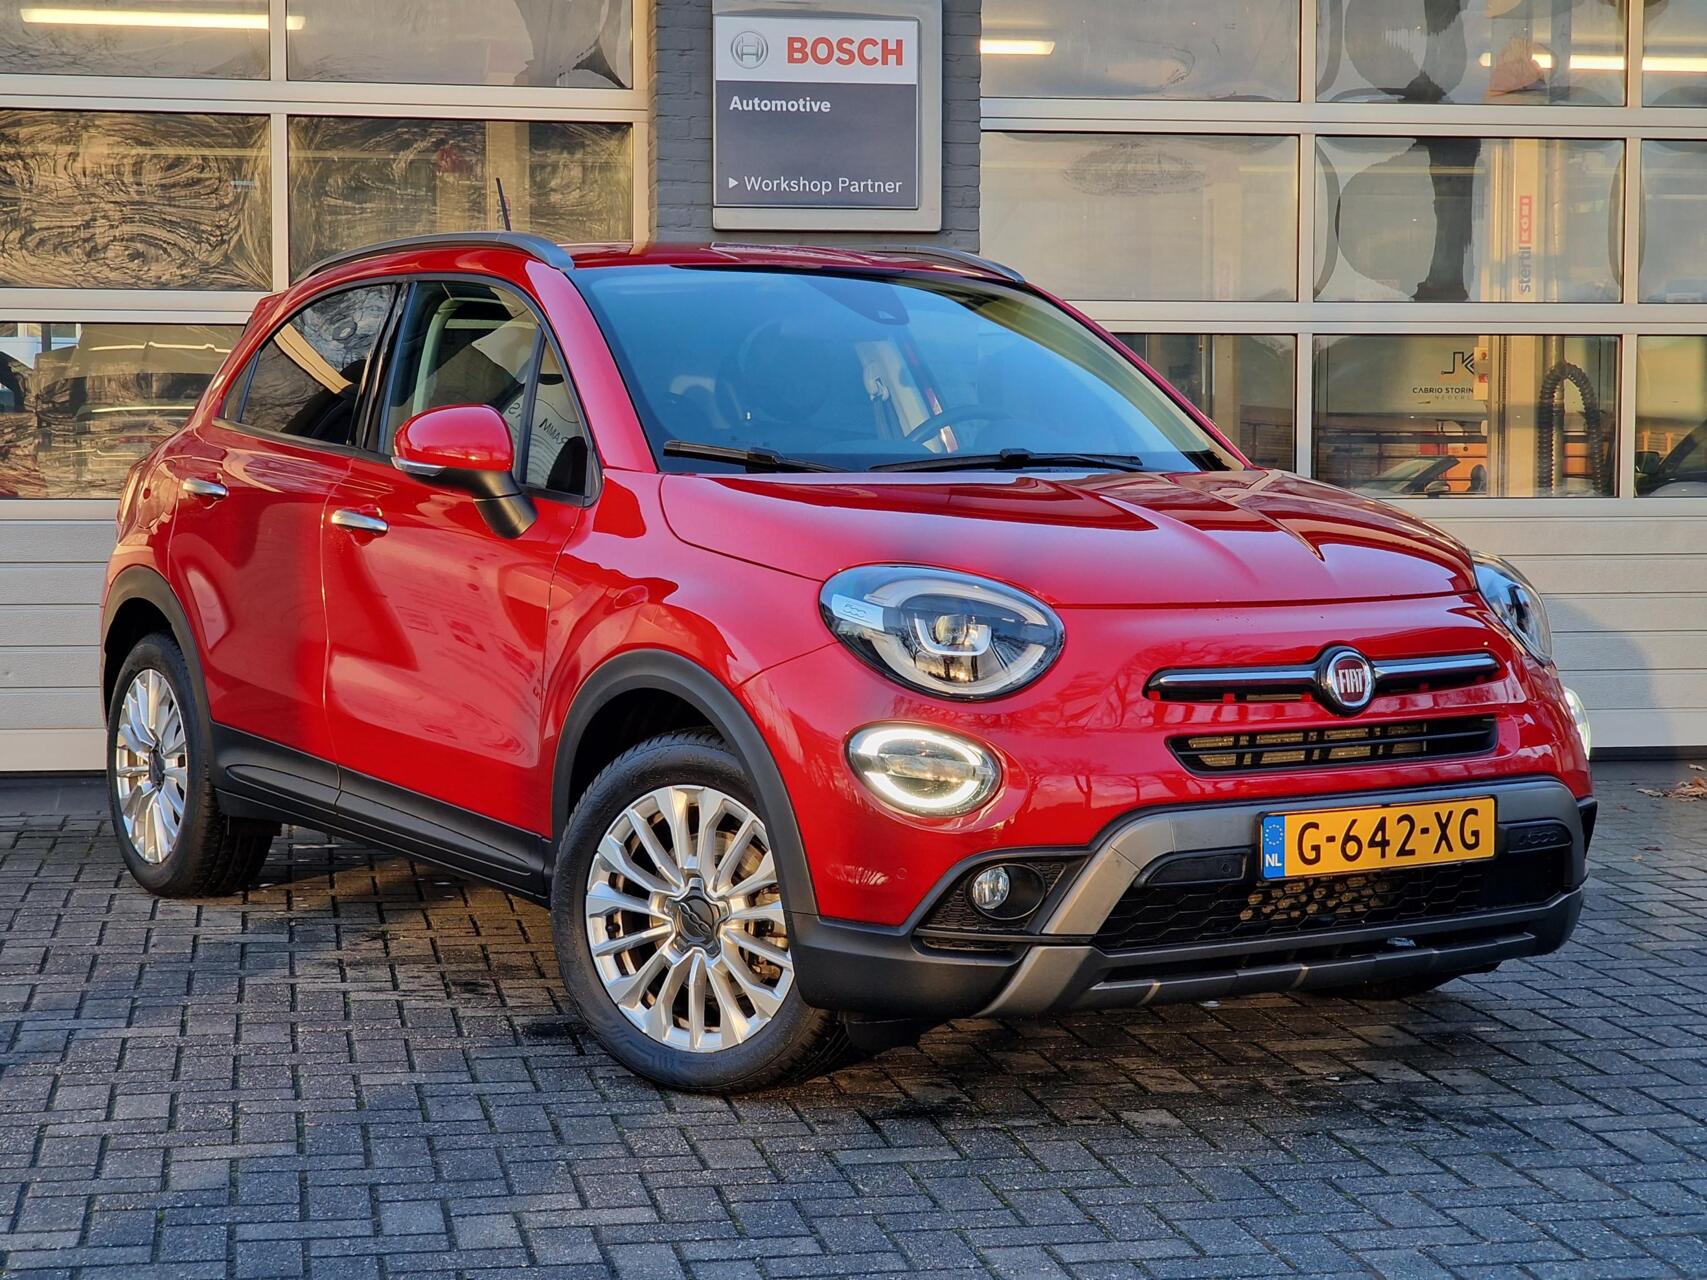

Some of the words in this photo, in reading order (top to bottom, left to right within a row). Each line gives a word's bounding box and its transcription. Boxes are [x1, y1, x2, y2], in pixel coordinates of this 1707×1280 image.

[787, 37, 904, 66] BOSCH
[729, 96, 832, 113] Automotive
[744, 176, 832, 195] Workshop
[838, 177, 903, 194] Partner
[1338, 668, 1364, 694] FIAT
[1297, 807, 1481, 866] G-642-XG
[1265, 853, 1283, 867] NL
